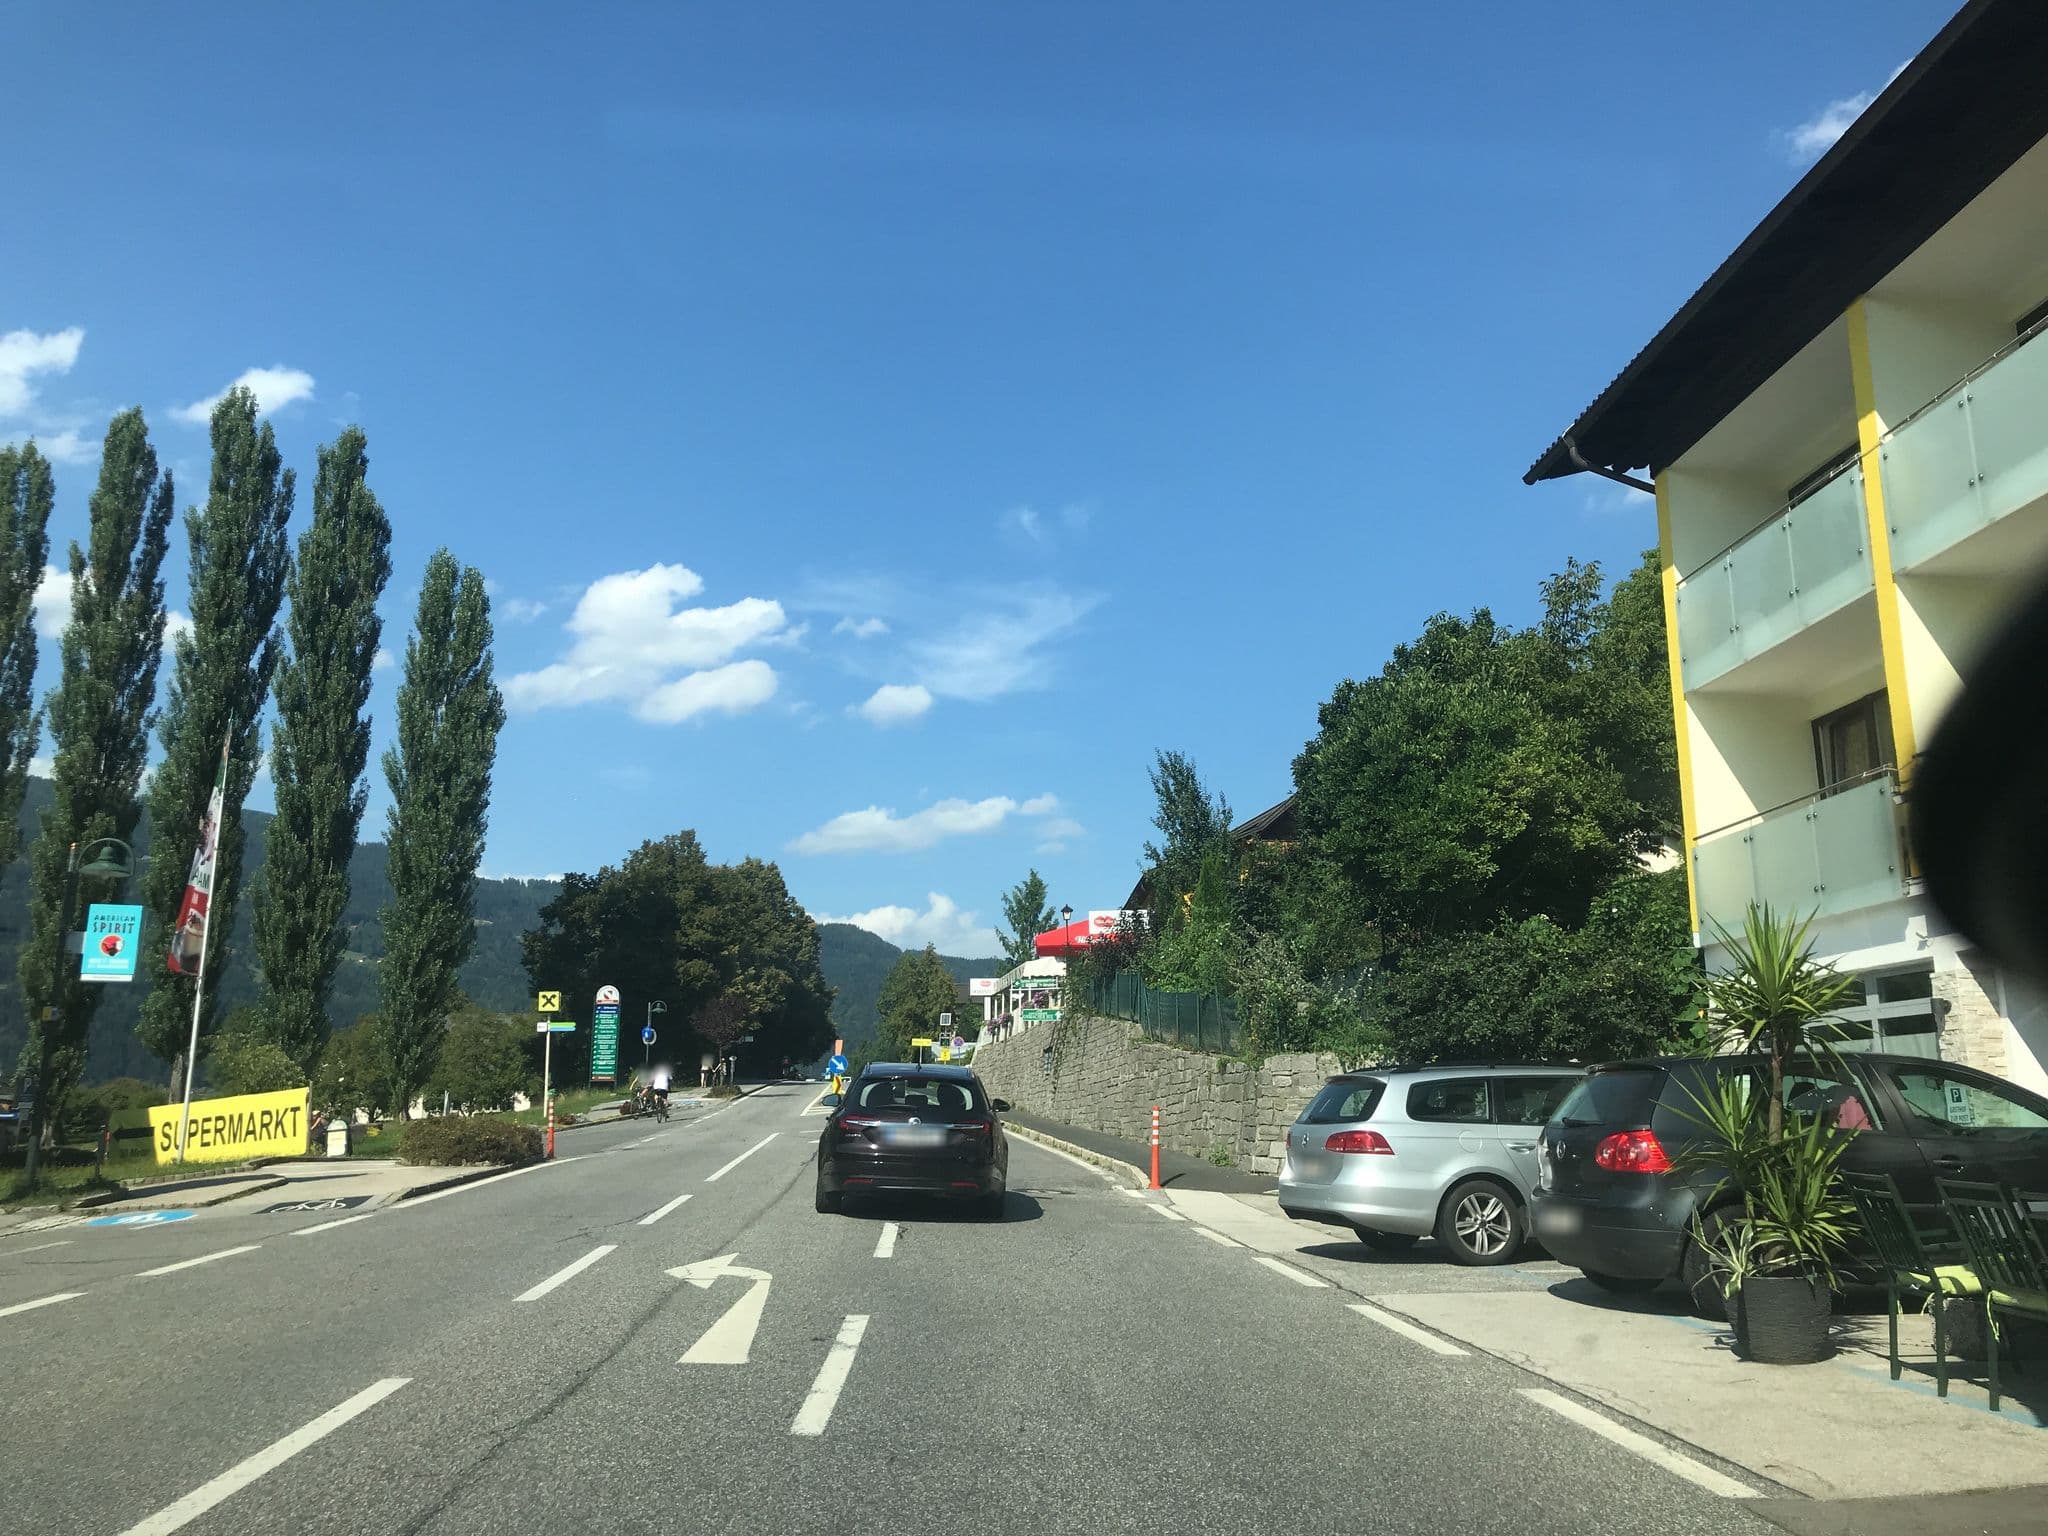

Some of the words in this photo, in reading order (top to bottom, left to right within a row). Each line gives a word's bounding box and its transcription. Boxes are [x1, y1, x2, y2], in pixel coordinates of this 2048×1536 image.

[93, 914, 136, 922] AMERICAN
[92, 922, 136, 934] SPIRIT
[159, 1106, 301, 1152] SUPERMARKT
